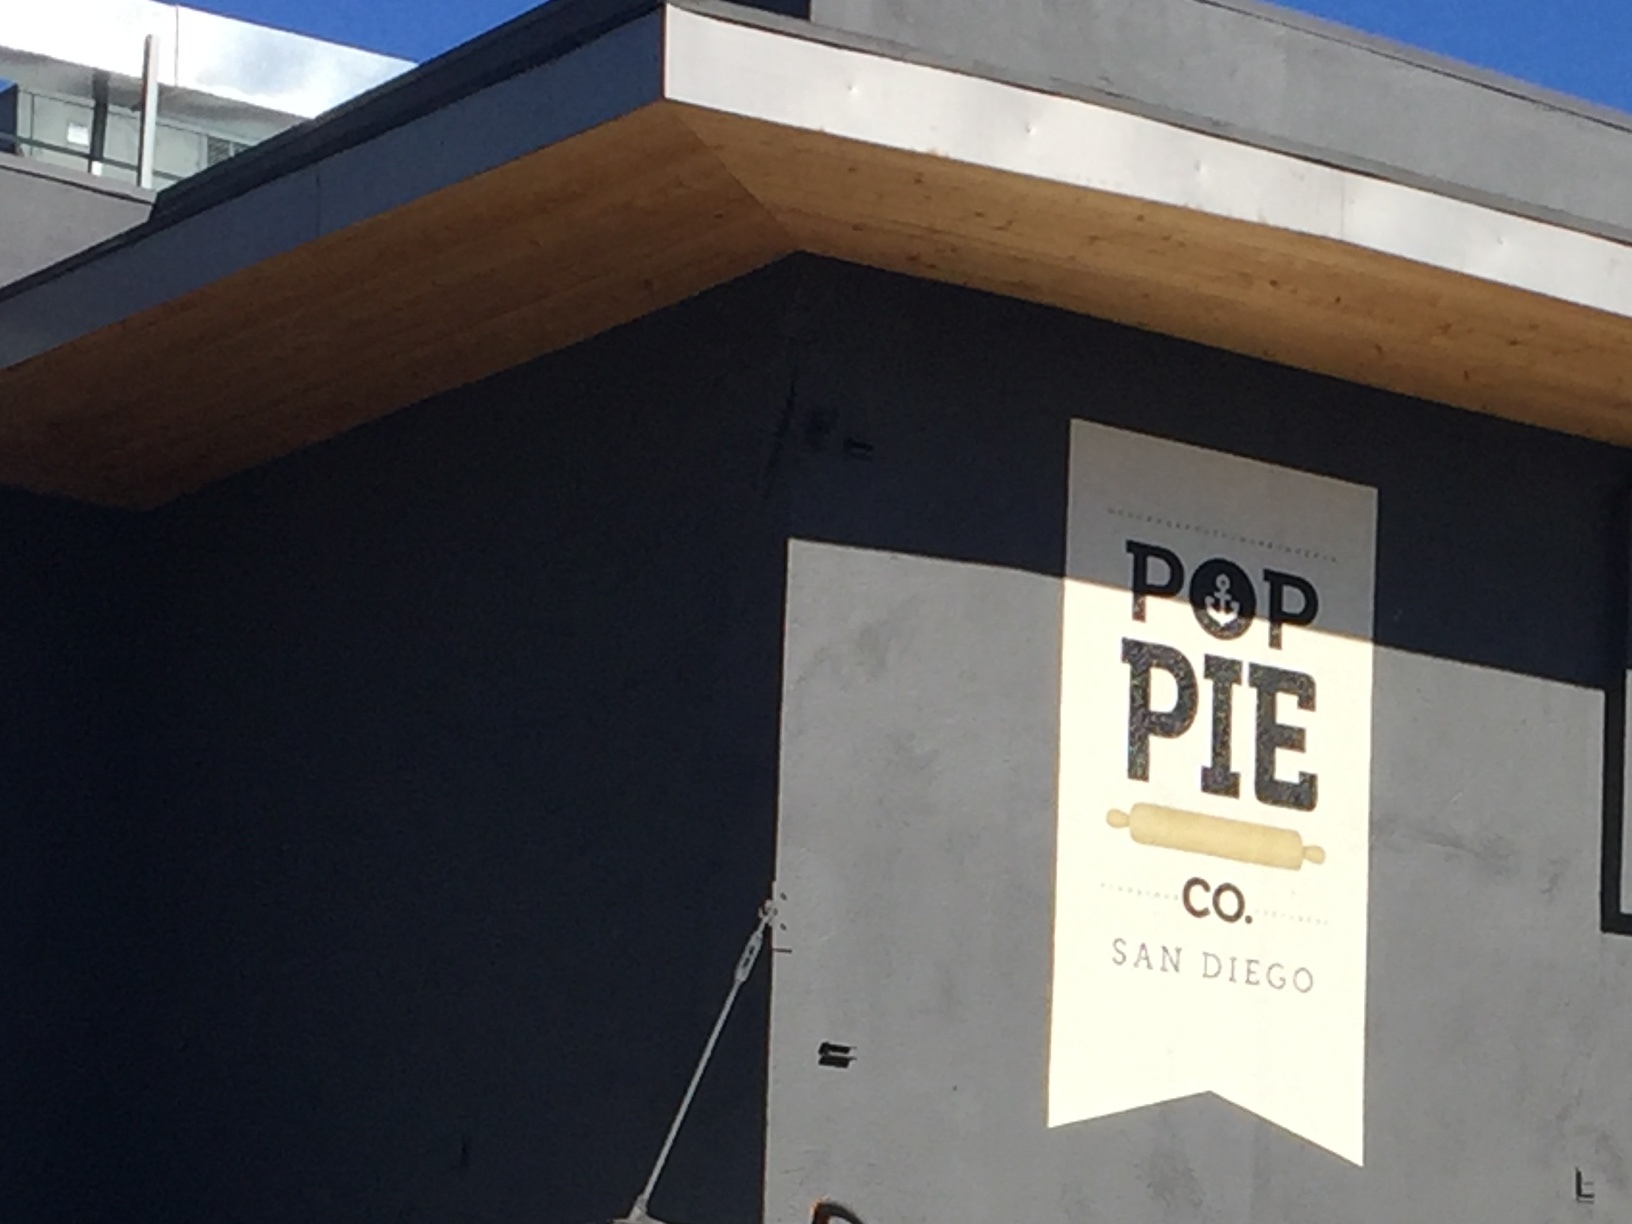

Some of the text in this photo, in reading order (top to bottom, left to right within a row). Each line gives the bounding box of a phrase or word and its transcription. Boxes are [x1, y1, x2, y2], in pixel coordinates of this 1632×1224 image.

[1120, 636, 1319, 812] PIE
[1181, 876, 1254, 925] CO.
[1111, 937, 1316, 994] SAN DIEGO
